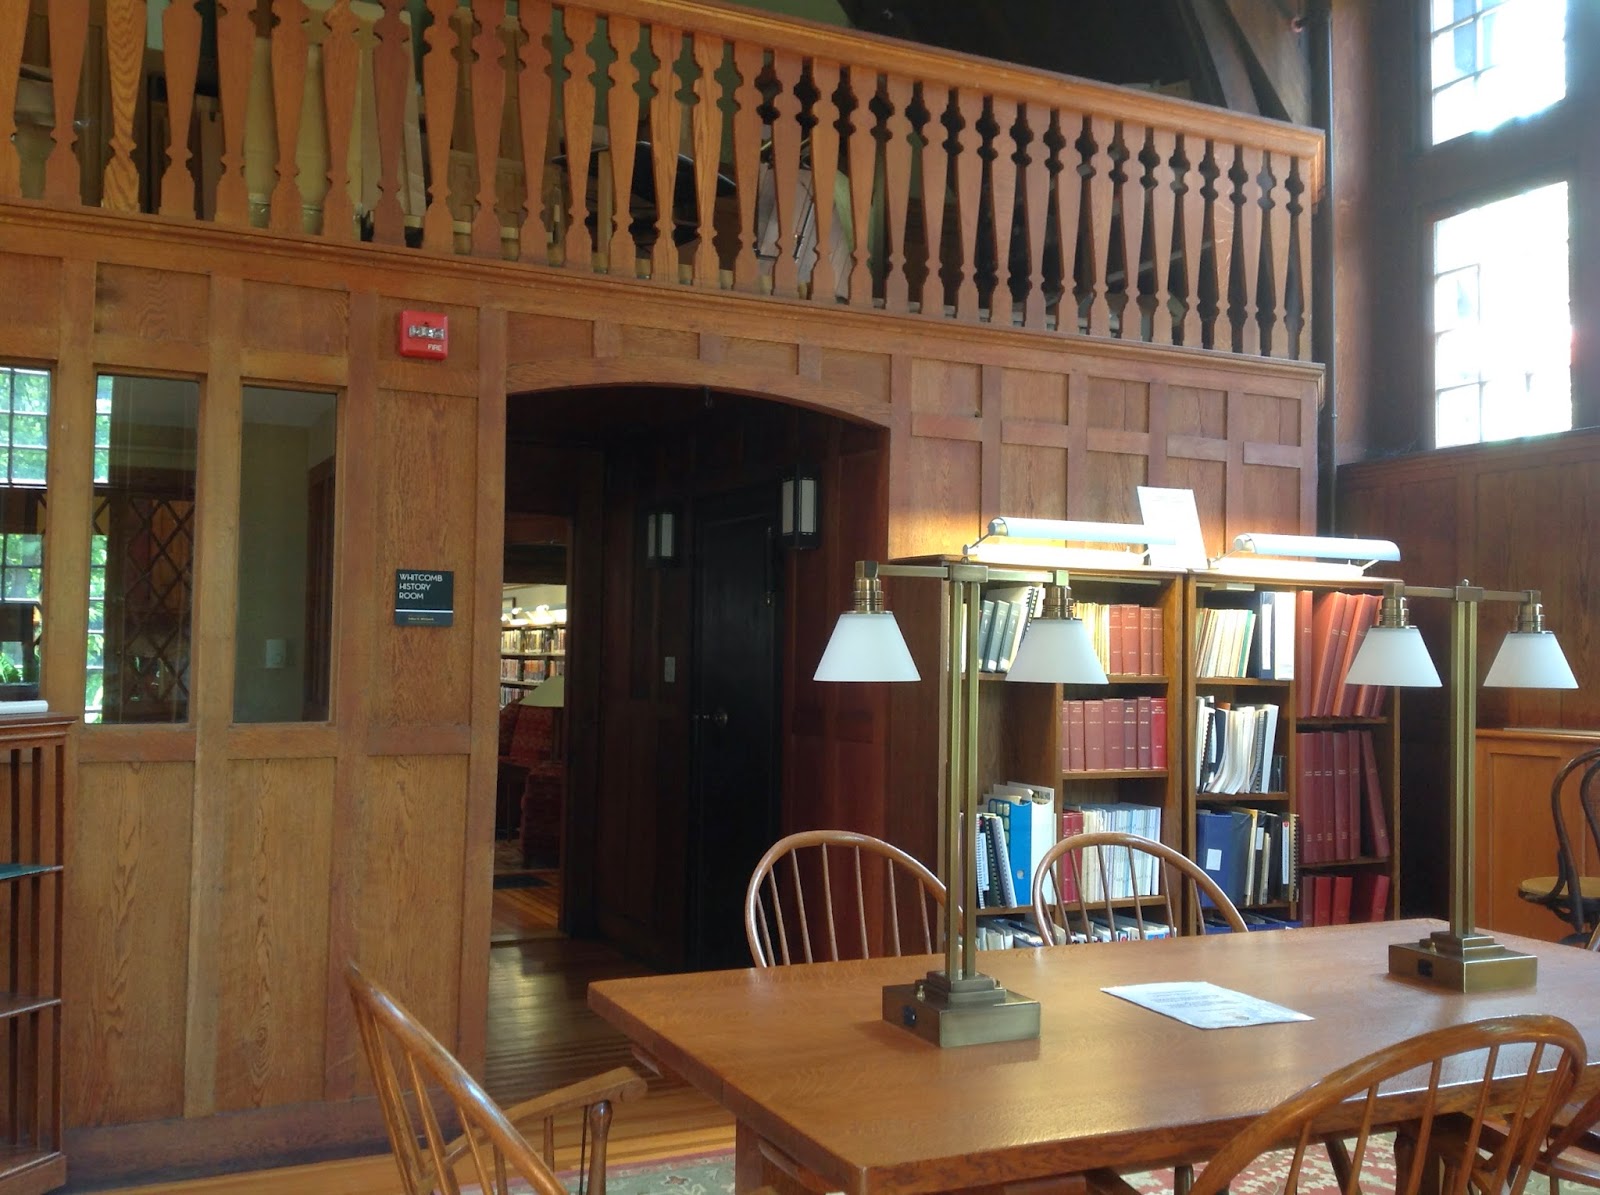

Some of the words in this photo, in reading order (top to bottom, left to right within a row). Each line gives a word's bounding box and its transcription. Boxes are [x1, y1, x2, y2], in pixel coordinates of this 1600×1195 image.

[427, 343, 442, 352] FIRE
[399, 573, 443, 582] WHITCOMB
[399, 583, 431, 591] HISTORY
[399, 592, 424, 600] ROOM
